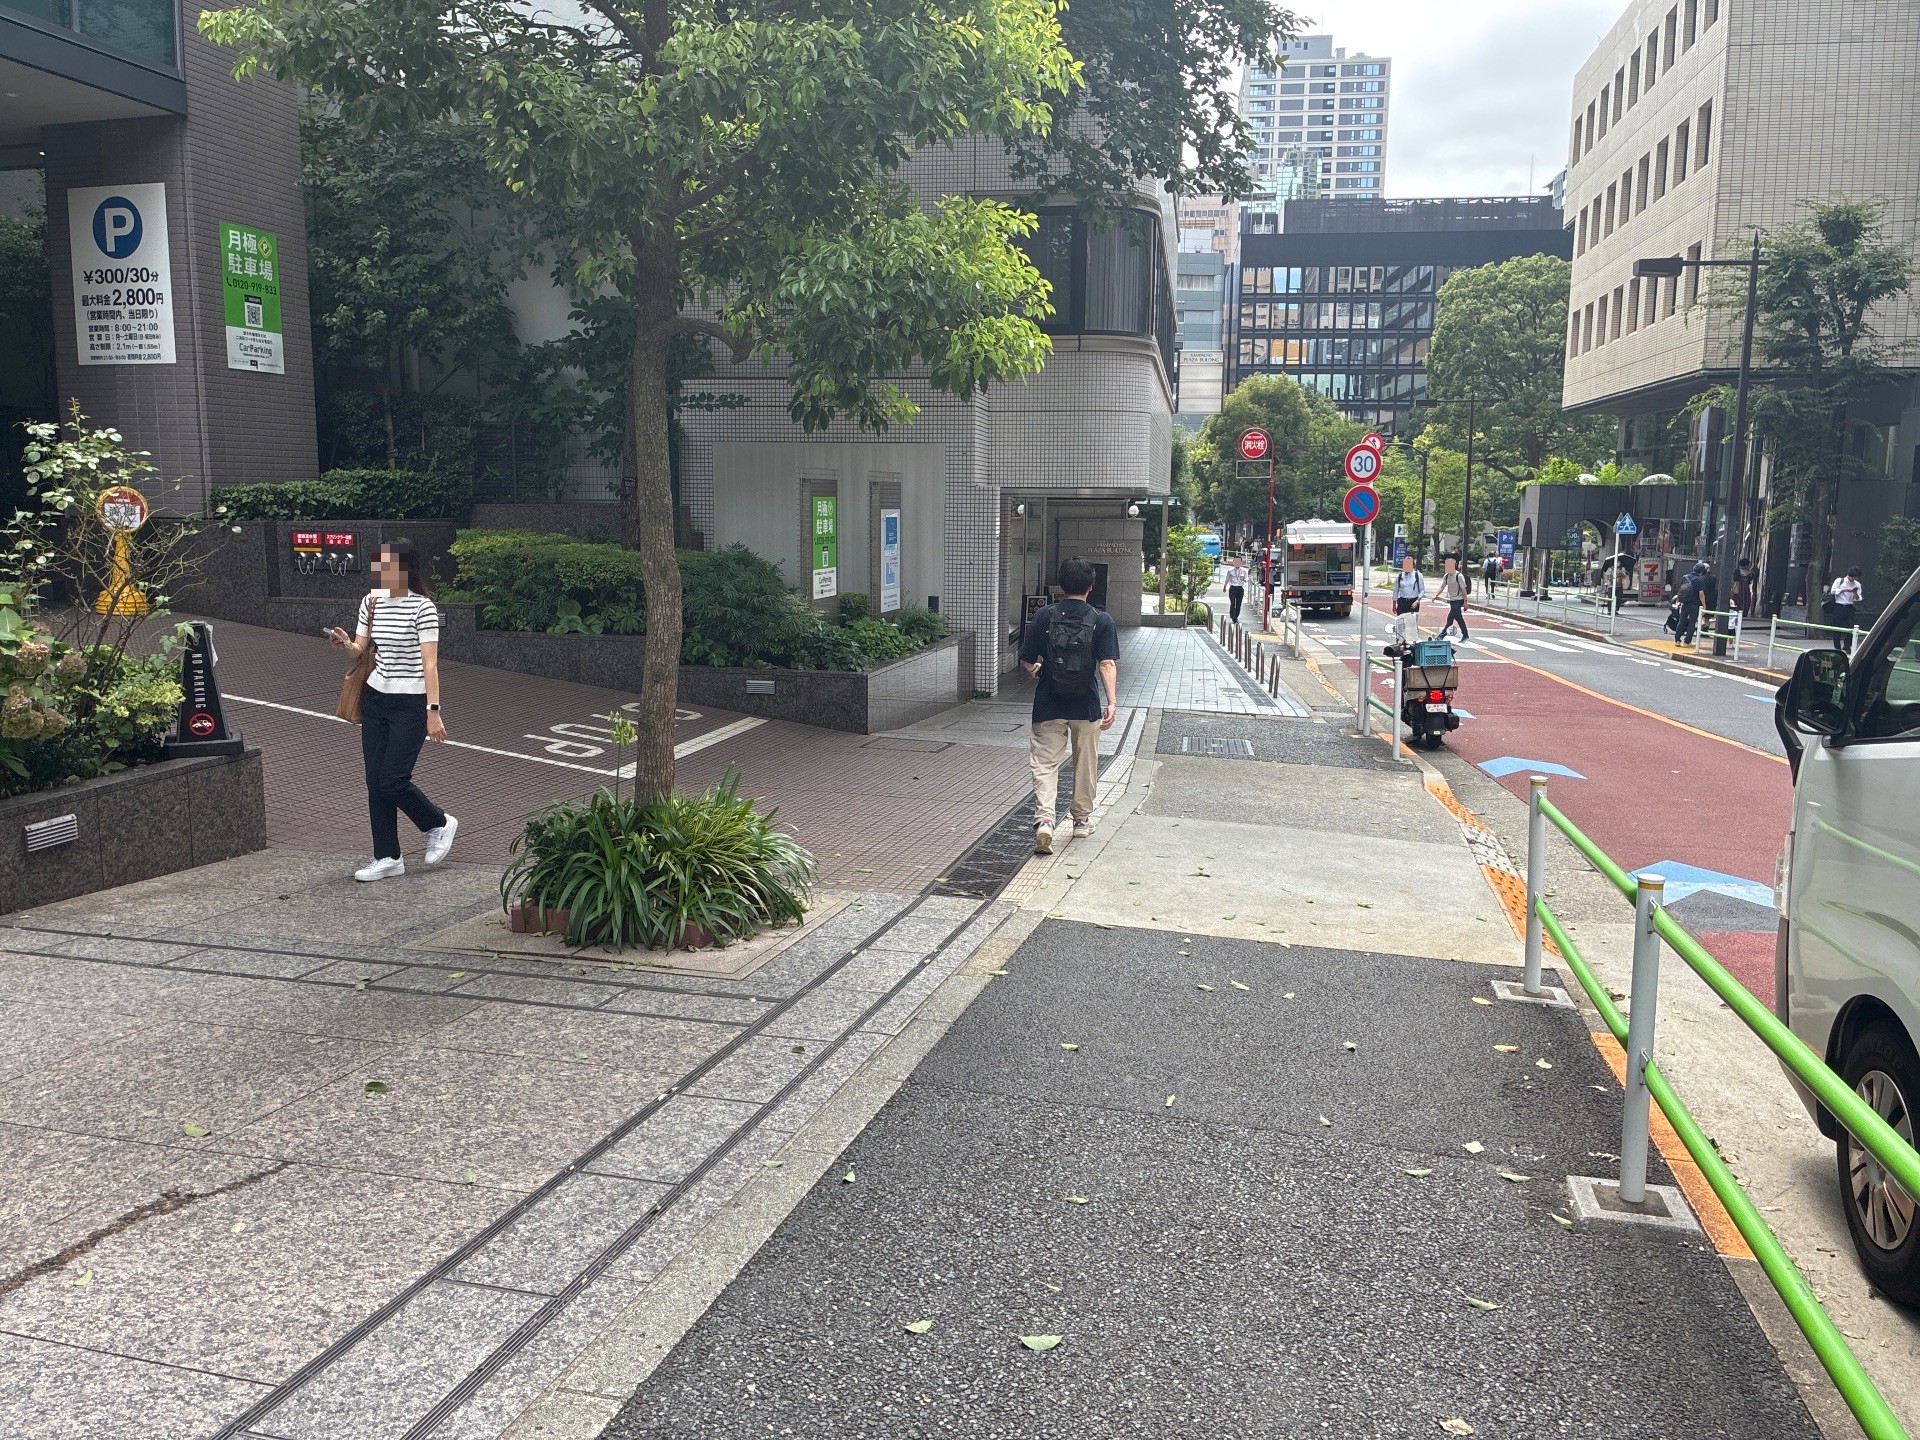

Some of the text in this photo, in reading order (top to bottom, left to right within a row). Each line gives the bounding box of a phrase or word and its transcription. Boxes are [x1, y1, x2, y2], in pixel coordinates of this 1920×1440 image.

[105, 208, 135, 252] P
[228, 230, 257, 254] 月極
[83, 267, 159, 285] ¥300/30分
[228, 253, 273, 281] 駐車場
[233, 279, 277, 295] 0120-919-833
[82, 288, 164, 309] 最大料金 2,800円
[239, 343, 272, 357] CarParking
[1245, 440, 1265, 450] 消火栓
[1354, 456, 1373, 472] 30
[192, 653, 207, 709] NO PARKING
